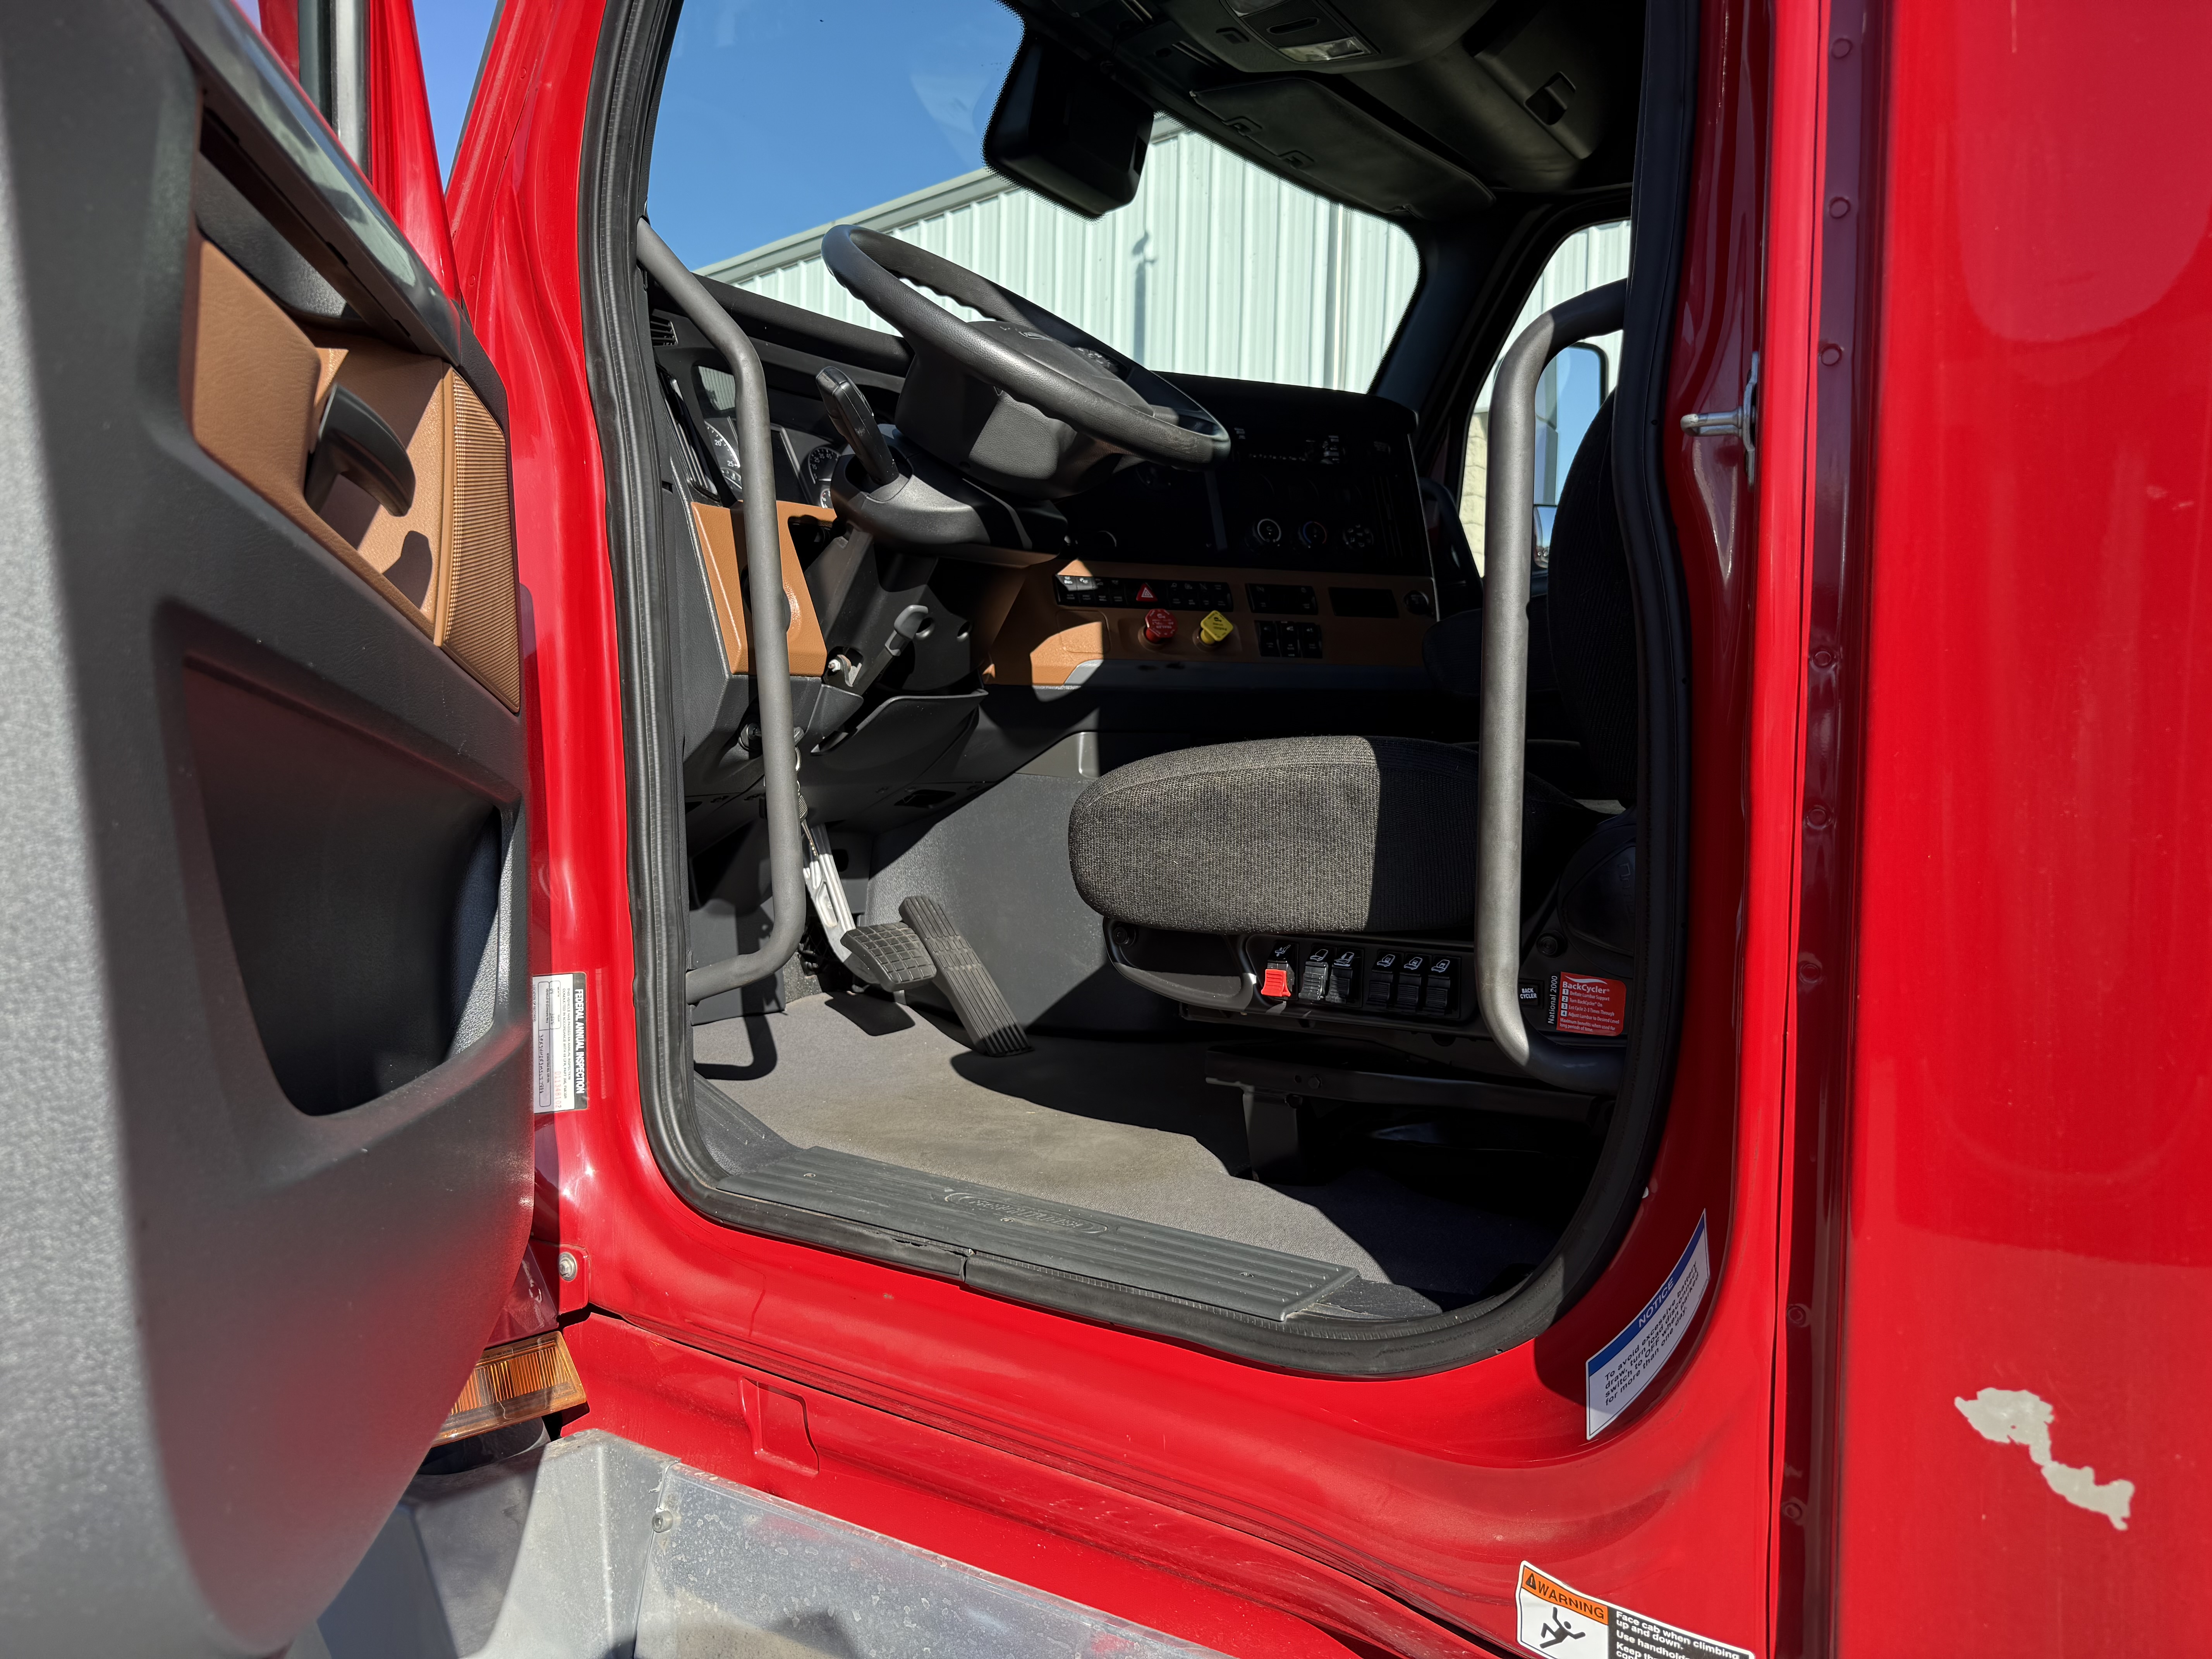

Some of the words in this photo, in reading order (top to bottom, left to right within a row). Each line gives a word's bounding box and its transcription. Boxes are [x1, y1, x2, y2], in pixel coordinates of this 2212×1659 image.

[575, 989, 584, 1021] FEDERAL
[1547, 994, 1556, 1024] National
[575, 1022, 584, 1050] ANNUAL
[576, 1052, 585, 1093] INSPECTION
[1605, 1369, 1615, 1381] To
[1618, 1345, 1640, 1369] avoid
[1642, 1300, 1676, 1345] excessive
[1677, 1261, 1697, 1298] battery
[1638, 1277, 1674, 1328] NOTICE
[1605, 1368, 1627, 1389] draw,
[1630, 1347, 1646, 1366] turn
[1648, 1325, 1664, 1347] load
[1665, 1268, 1698, 1327] disconnect
[1605, 1370, 1633, 1398] switch
[1635, 1358, 1643, 1369] to
[1645, 1339, 1660, 1358] OFF
[1662, 1316, 1679, 1339] when
[1681, 1272, 1699, 1312] parked
[1605, 1392, 1618, 1406] for
[1620, 1369, 1640, 1392] more
[1643, 1348, 1659, 1369] than
[1661, 1328, 1673, 1347] one
[1675, 1306, 1687, 1328] day.
[1537, 1580, 1605, 1620] WARNING
[1616, 1611, 1640, 1625] Face
[1642, 1622, 1660, 1634] cab
[1663, 1630, 1691, 1645] when
[1693, 1641, 1740, 1659] climbing
[1616, 1620, 1629, 1630] up
[1632, 1626, 1650, 1638] and
[1652, 1633, 1683, 1650] down.
[1616, 1630, 1635, 1644] Use
[1616, 1642, 1642, 1659] Keep
